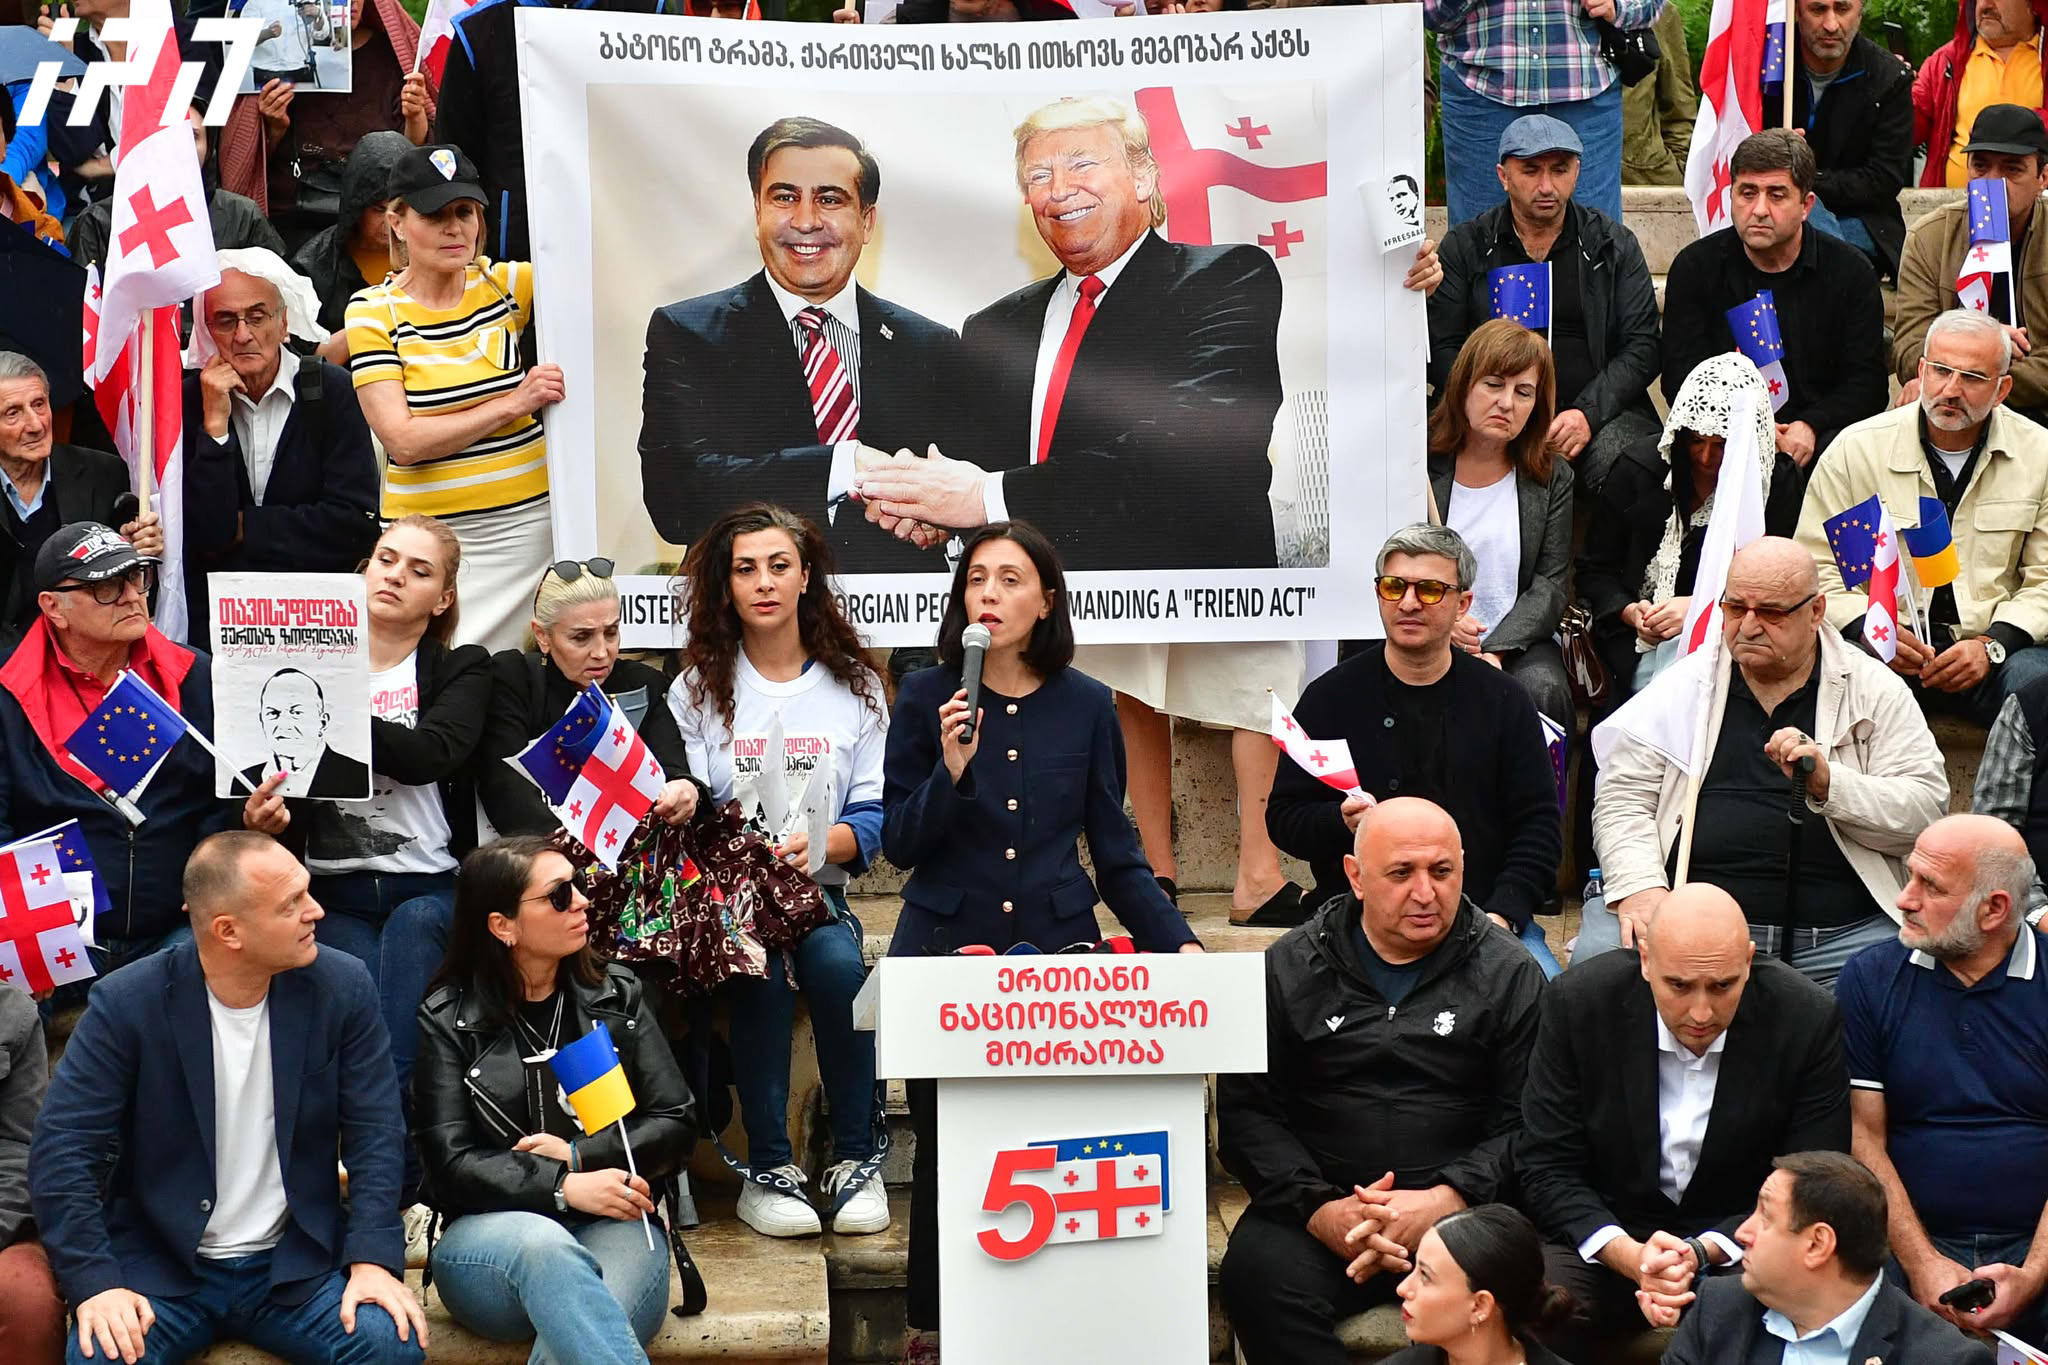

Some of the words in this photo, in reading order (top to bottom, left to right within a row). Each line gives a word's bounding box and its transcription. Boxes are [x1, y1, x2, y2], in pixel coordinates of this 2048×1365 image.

[599, 31, 702, 63] ბატონო
[708, 38, 795, 69] ტრამპ,
[801, 42, 935, 71] ქართველი
[941, 42, 1021, 71] ხალხი
[1028, 38, 1124, 69] ითხოვს
[1131, 31, 1244, 66] მეგობარ
[1250, 28, 1310, 60] აქტს
[218, 597, 359, 628] თავისუფლება
[836, 593, 909, 624] ORGIAN
[916, 592, 951, 623] PEO
[1067, 589, 1159, 620] MANDING
[1165, 589, 1179, 619] A
[1184, 588, 1264, 618] "FRIEND
[1269, 587, 1316, 617] ACT"
[220, 627, 276, 646] მურთაზ
[734, 737, 830, 756] თავიფლება
[997, 965, 1150, 993] ერთიანი
[939, 999, 1209, 1032] ნაციონალური
[985, 1039, 1165, 1067] მოძრაობა
[844, 1133, 888, 1189] MARC
[977, 1147, 1058, 1261] 5
